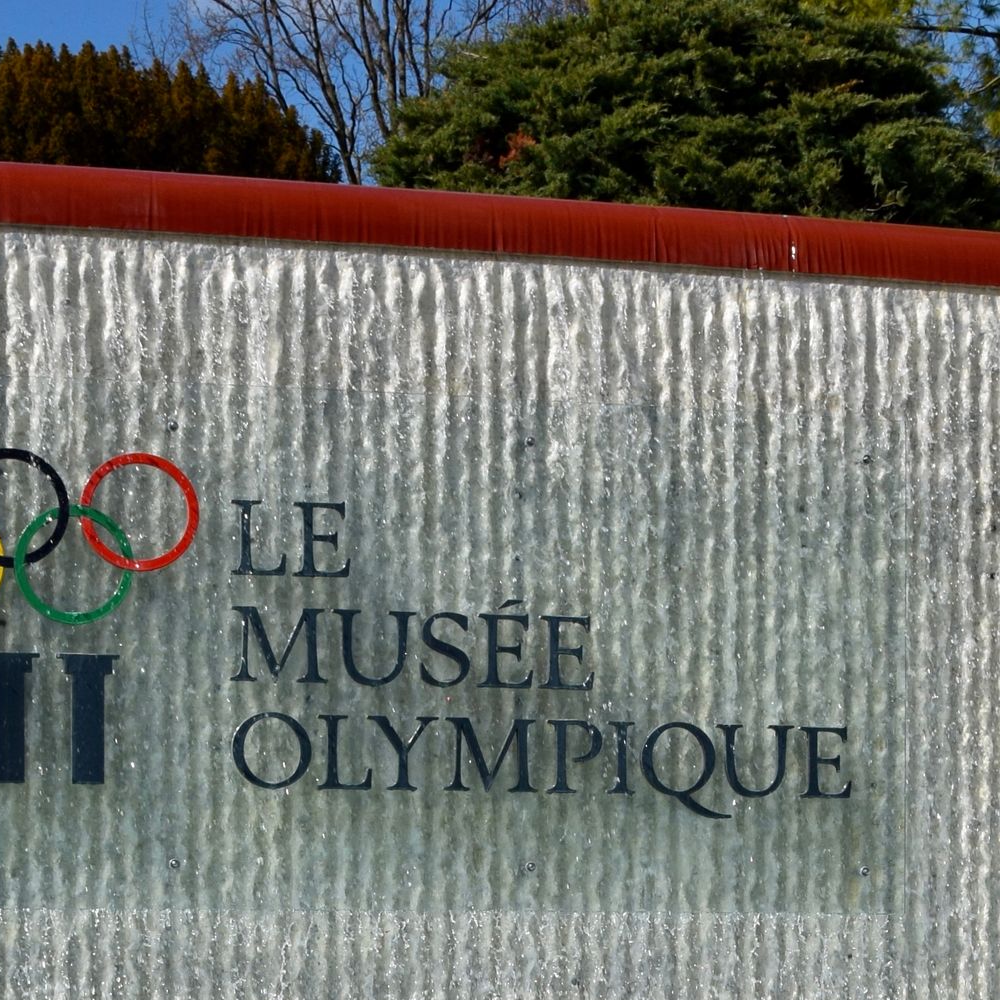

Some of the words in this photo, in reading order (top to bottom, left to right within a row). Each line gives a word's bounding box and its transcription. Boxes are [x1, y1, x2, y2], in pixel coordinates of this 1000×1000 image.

[231, 499, 351, 578] LE
[230, 600, 595, 690] MUSÉE
[232, 712, 852, 818] OLYMPIQUE
